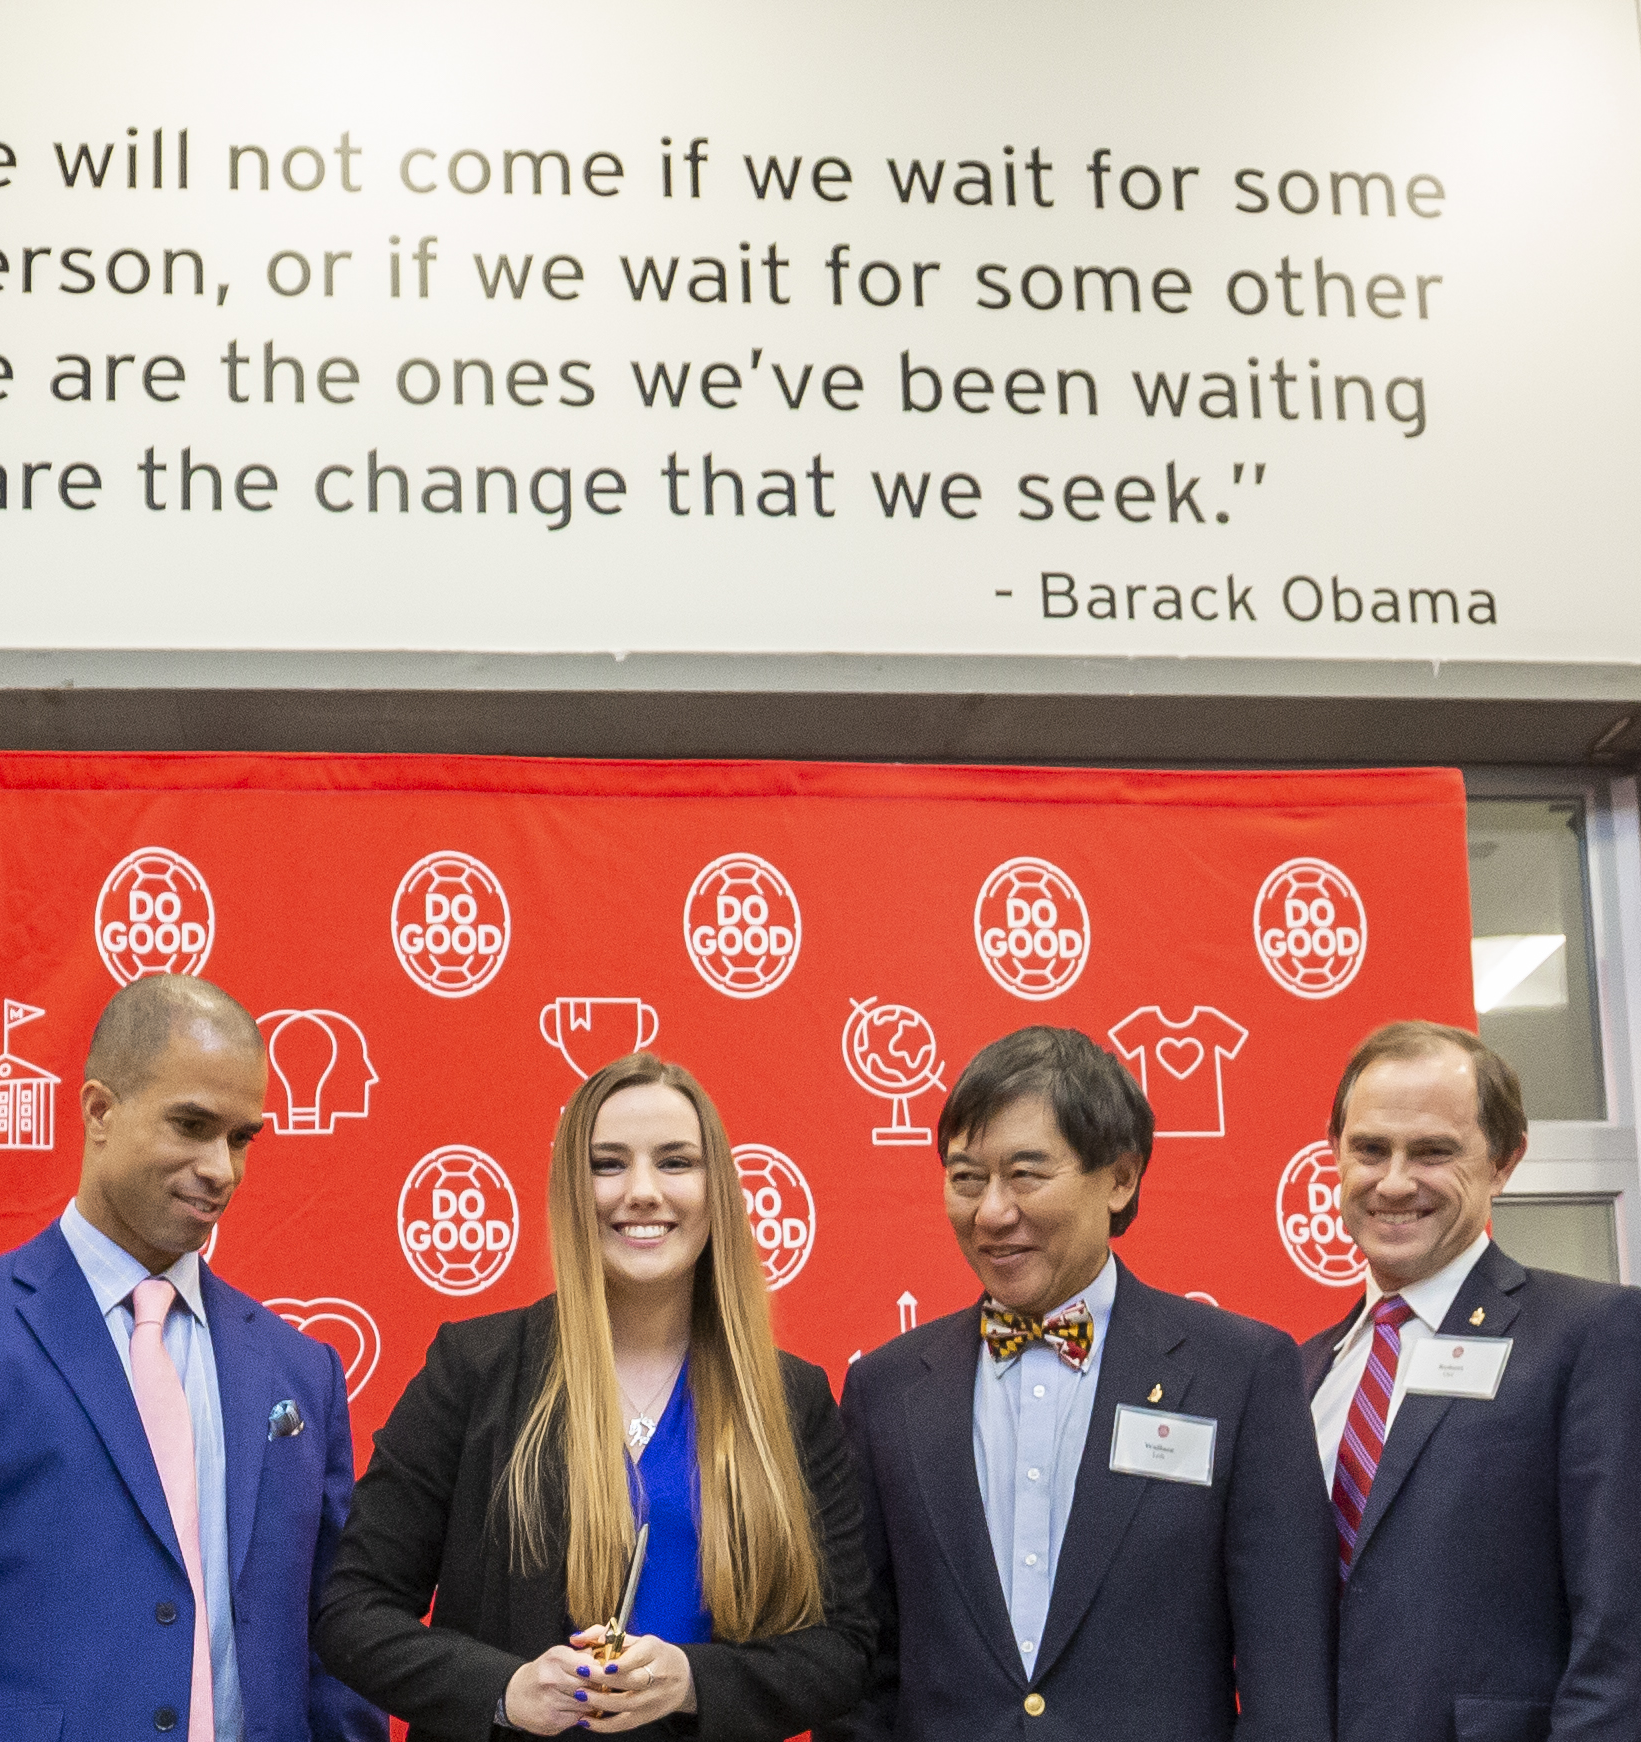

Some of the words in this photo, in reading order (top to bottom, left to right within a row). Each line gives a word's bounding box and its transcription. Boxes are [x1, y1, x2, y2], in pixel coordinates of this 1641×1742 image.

[53, 127, 187, 189] will
[229, 132, 363, 193] not
[400, 149, 624, 197] come
[661, 136, 708, 198] if
[743, 155, 852, 202] we
[886, 145, 1054, 208] wait
[1086, 148, 1200, 211] for
[1235, 168, 1447, 218] some
[267, 250, 352, 297] or
[389, 236, 437, 298] if
[474, 254, 584, 301] we
[619, 241, 790, 305] wait
[825, 243, 941, 308] for
[976, 263, 1192, 314] some
[1227, 255, 1444, 319] other
[50, 354, 185, 403] are
[220, 339, 360, 404] the
[396, 358, 595, 407] ones
[900, 349, 1098, 416] been
[1132, 357, 1426, 439] waiting
[137, 445, 278, 512] the
[315, 448, 627, 531] change
[661, 451, 835, 518] that
[871, 471, 982, 520] we
[1041, 572, 1257, 622] Barack
[1282, 574, 1497, 625] Obama
[129, 890, 181, 924] DO
[425, 893, 477, 925] DO
[717, 895, 769, 926] DO
[1007, 898, 1058, 928] DO
[1285, 898, 1335, 929] DO
[103, 921, 205, 954] GOOD
[399, 924, 503, 955] GOOD
[692, 925, 793, 956] GOOD
[983, 927, 1083, 959] GOOD
[1263, 927, 1359, 957] GOOD
[432, 1188, 485, 1220] DO
[742, 1186, 782, 1219] O
[406, 1220, 510, 1252] GOOD
